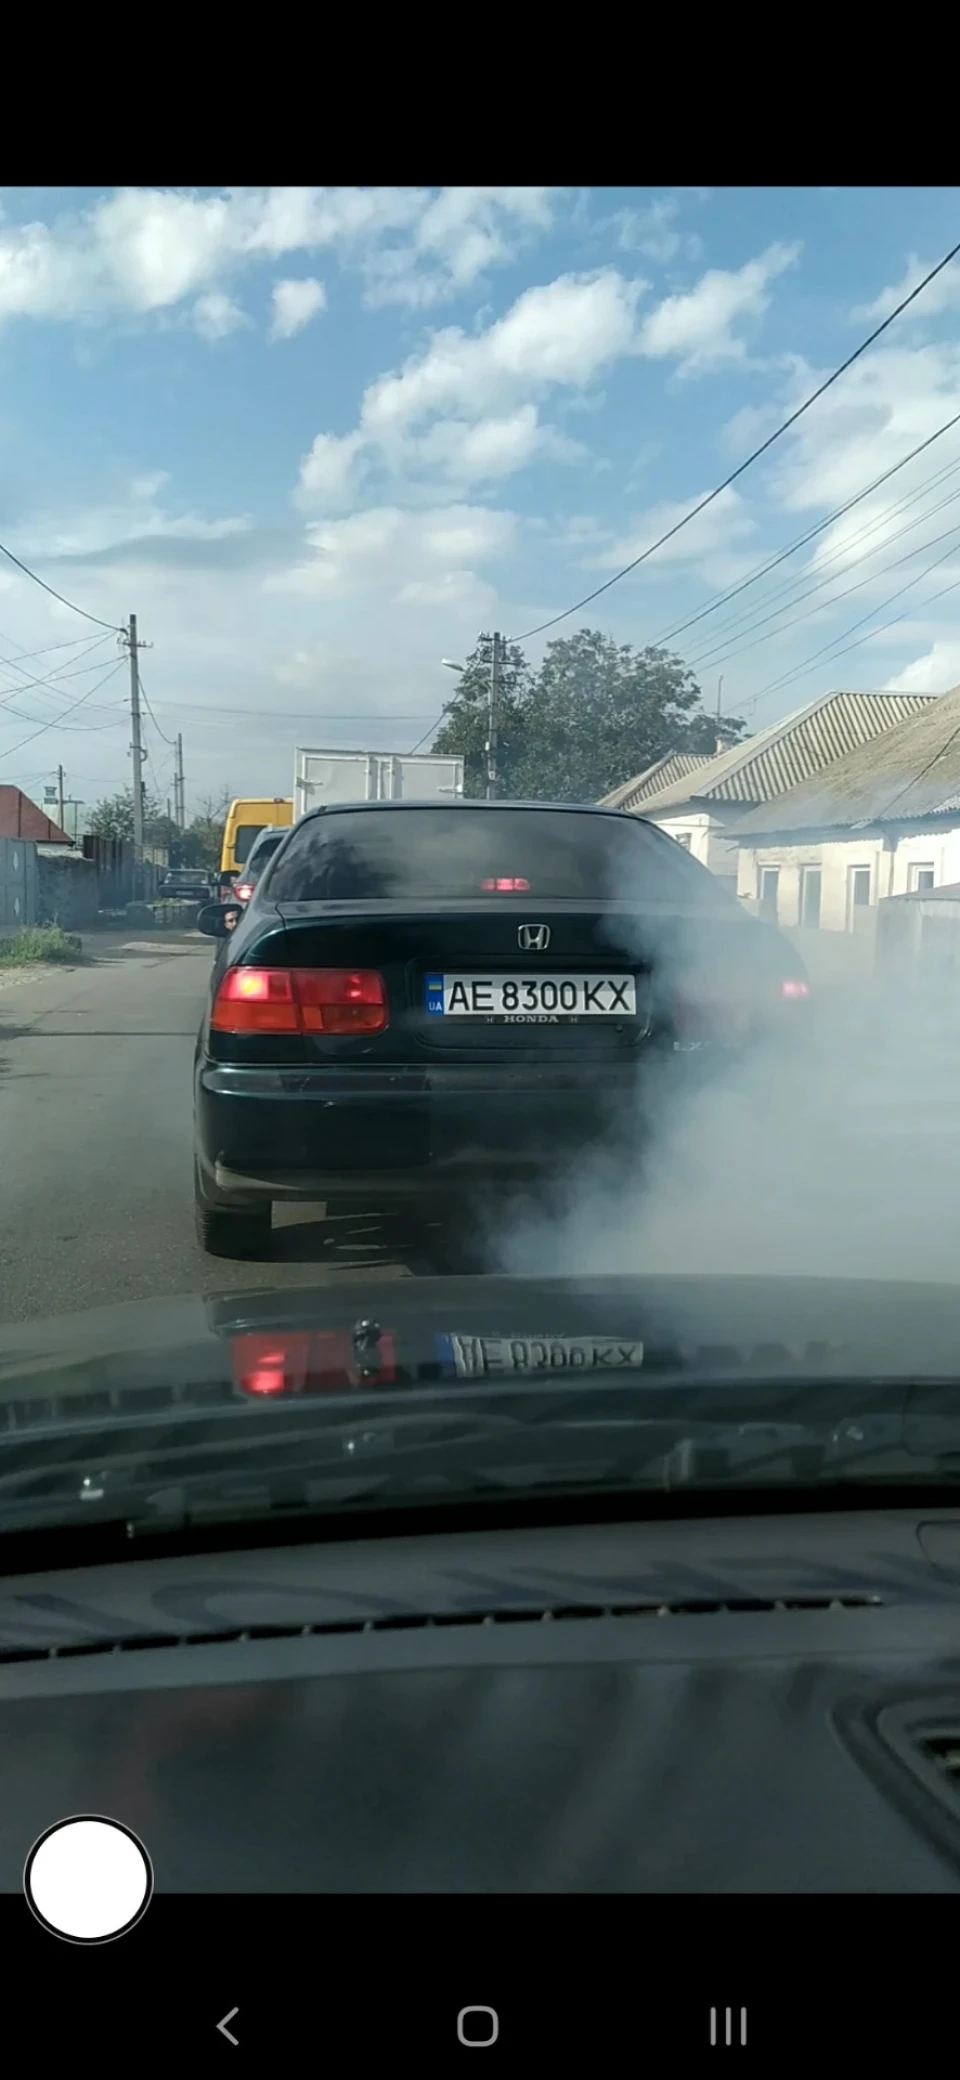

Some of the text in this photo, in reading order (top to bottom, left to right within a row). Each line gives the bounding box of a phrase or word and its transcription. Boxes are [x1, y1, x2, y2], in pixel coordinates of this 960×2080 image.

[448, 980, 631, 1011] AE 8300 KX
[428, 1002, 442, 1012] UA
[503, 1015, 559, 1023] HONDA
